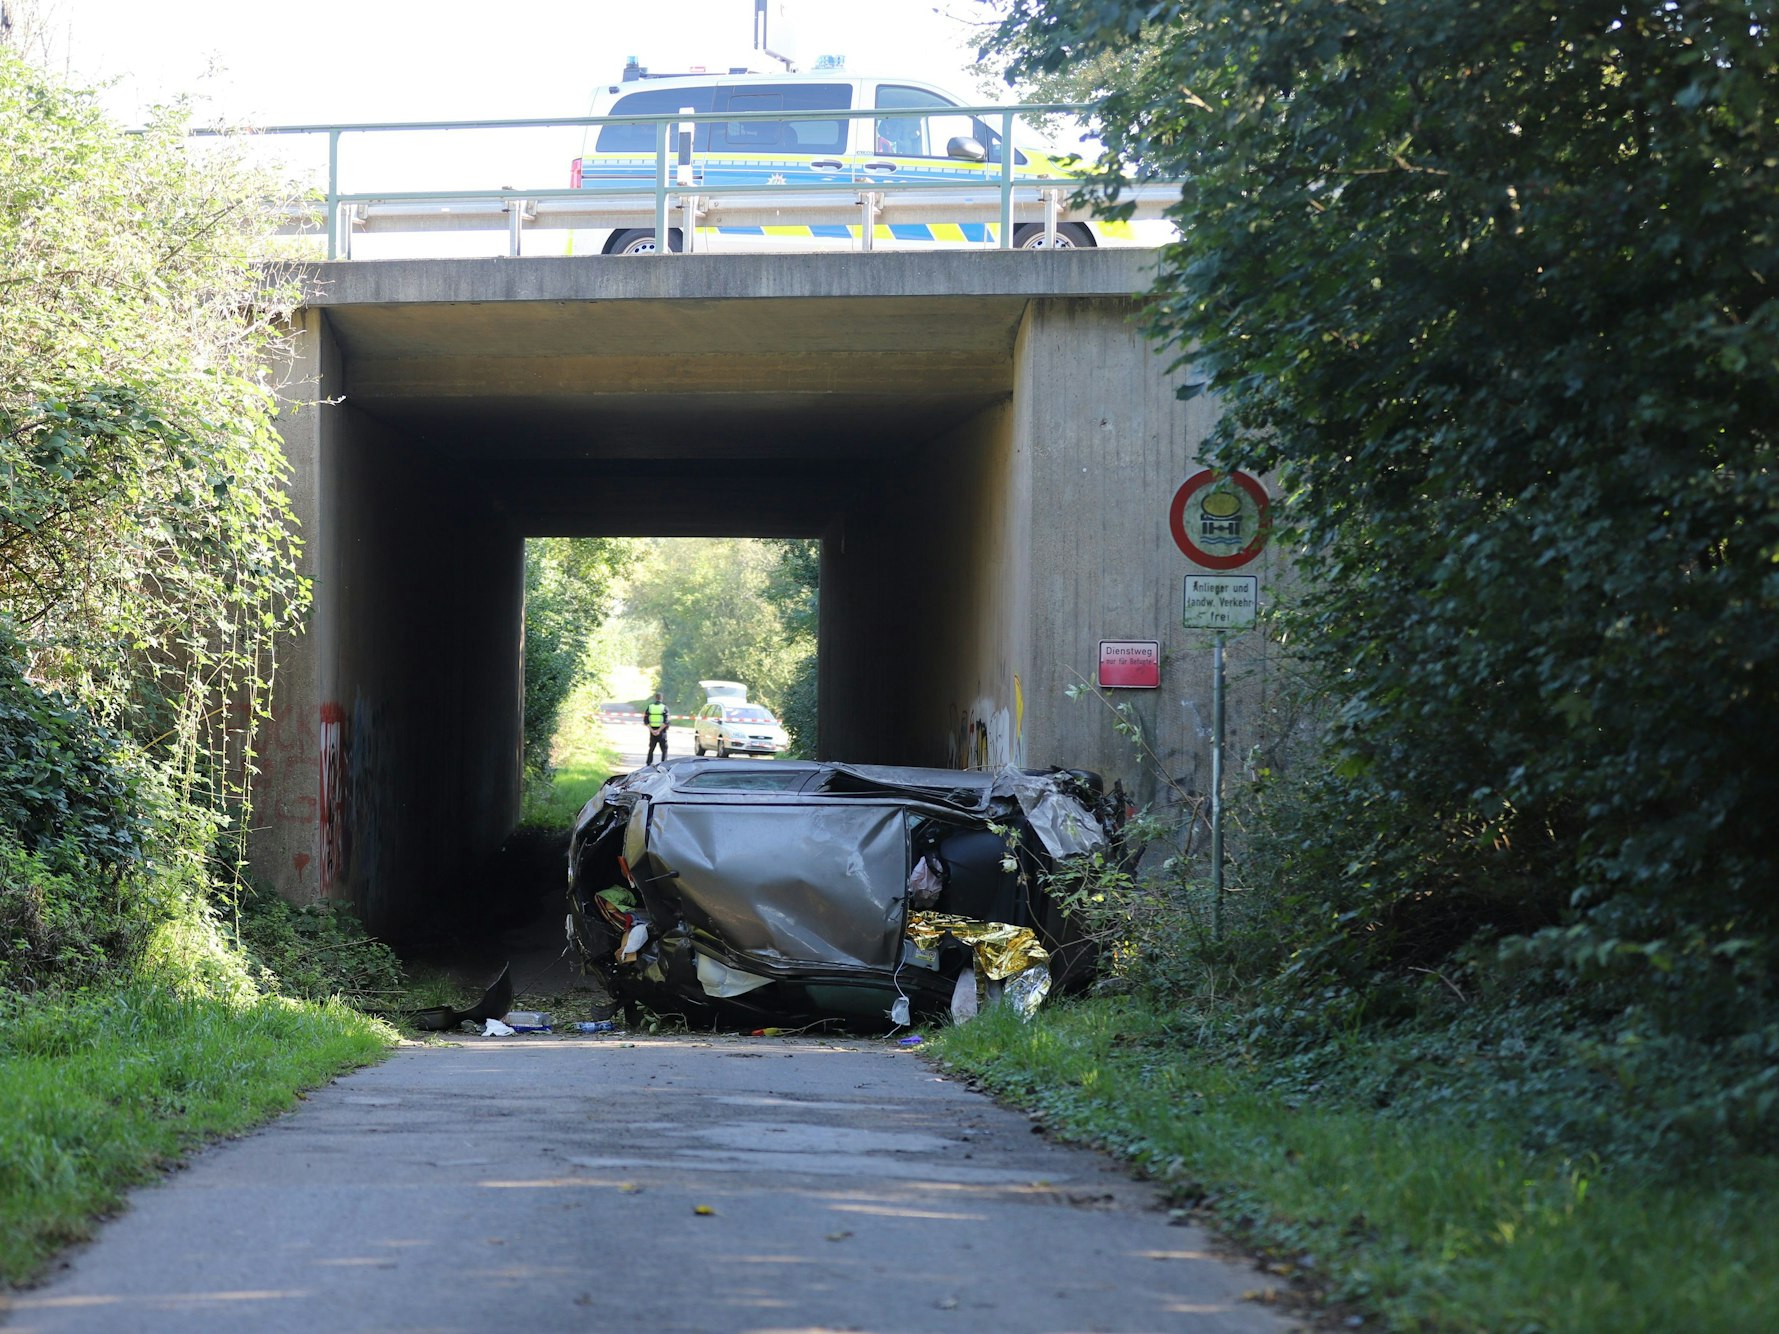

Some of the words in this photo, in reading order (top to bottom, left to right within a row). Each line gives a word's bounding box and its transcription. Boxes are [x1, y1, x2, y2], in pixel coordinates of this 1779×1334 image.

[1193, 582, 1229, 595] Anlieger
[1233, 583, 1249, 593] und
[1210, 611, 1230, 622] frei
[1106, 646, 1152, 657] Dienstweg
